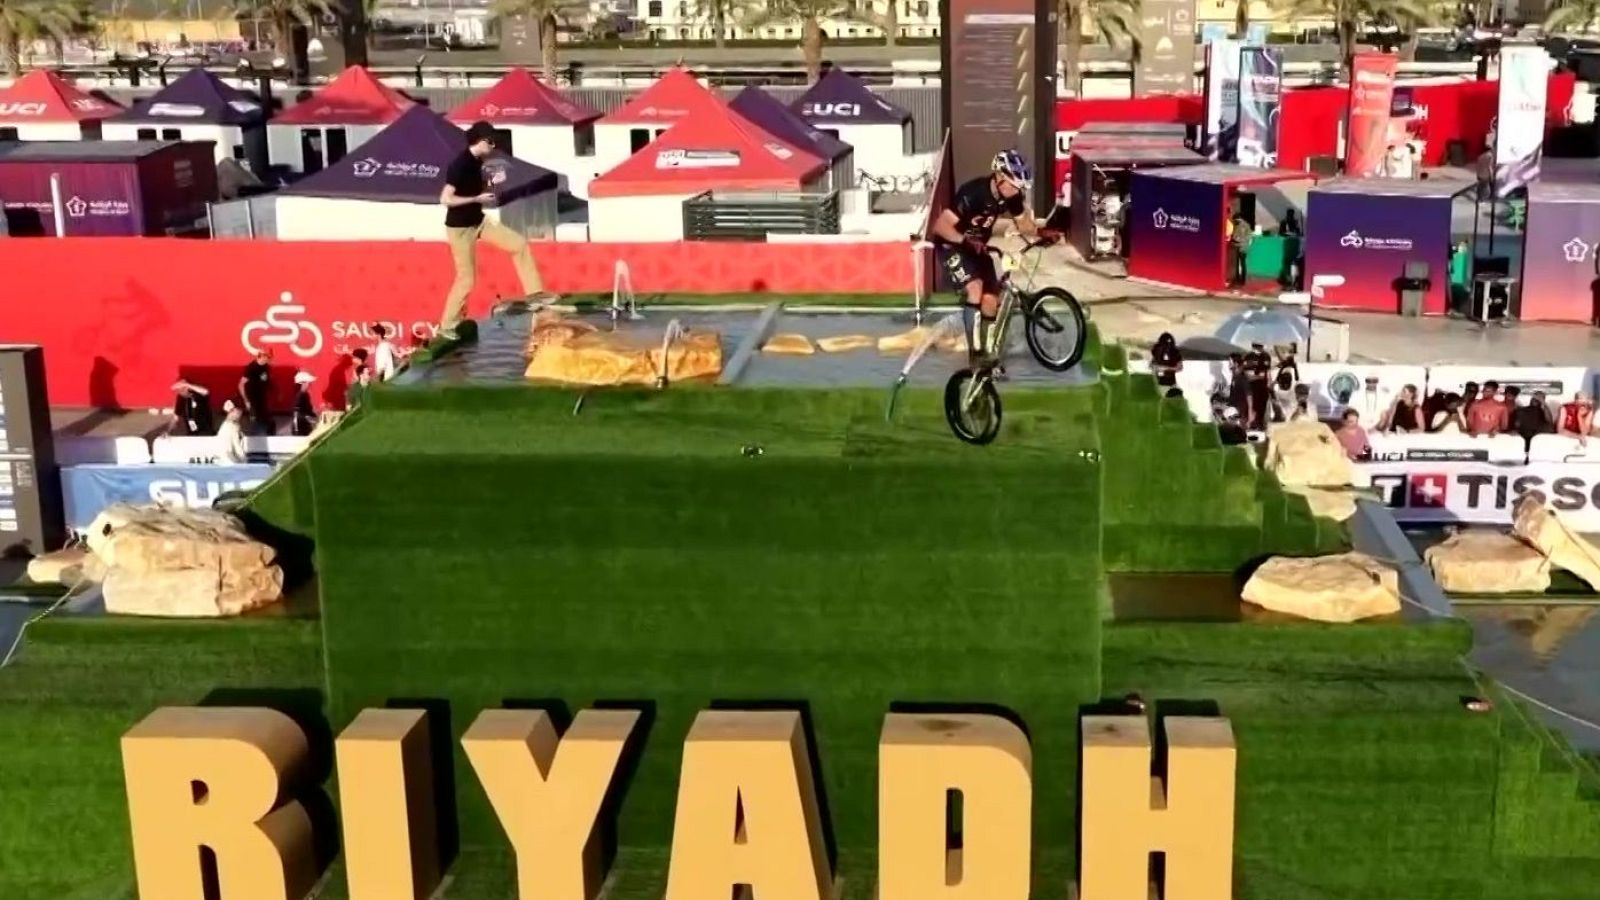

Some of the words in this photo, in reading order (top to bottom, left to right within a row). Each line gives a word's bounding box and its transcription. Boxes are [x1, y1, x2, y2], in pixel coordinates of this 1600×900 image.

[813, 103, 861, 116] UCI
[1457, 474, 1600, 510] TISS
[120, 707, 1237, 900] RIYADH
